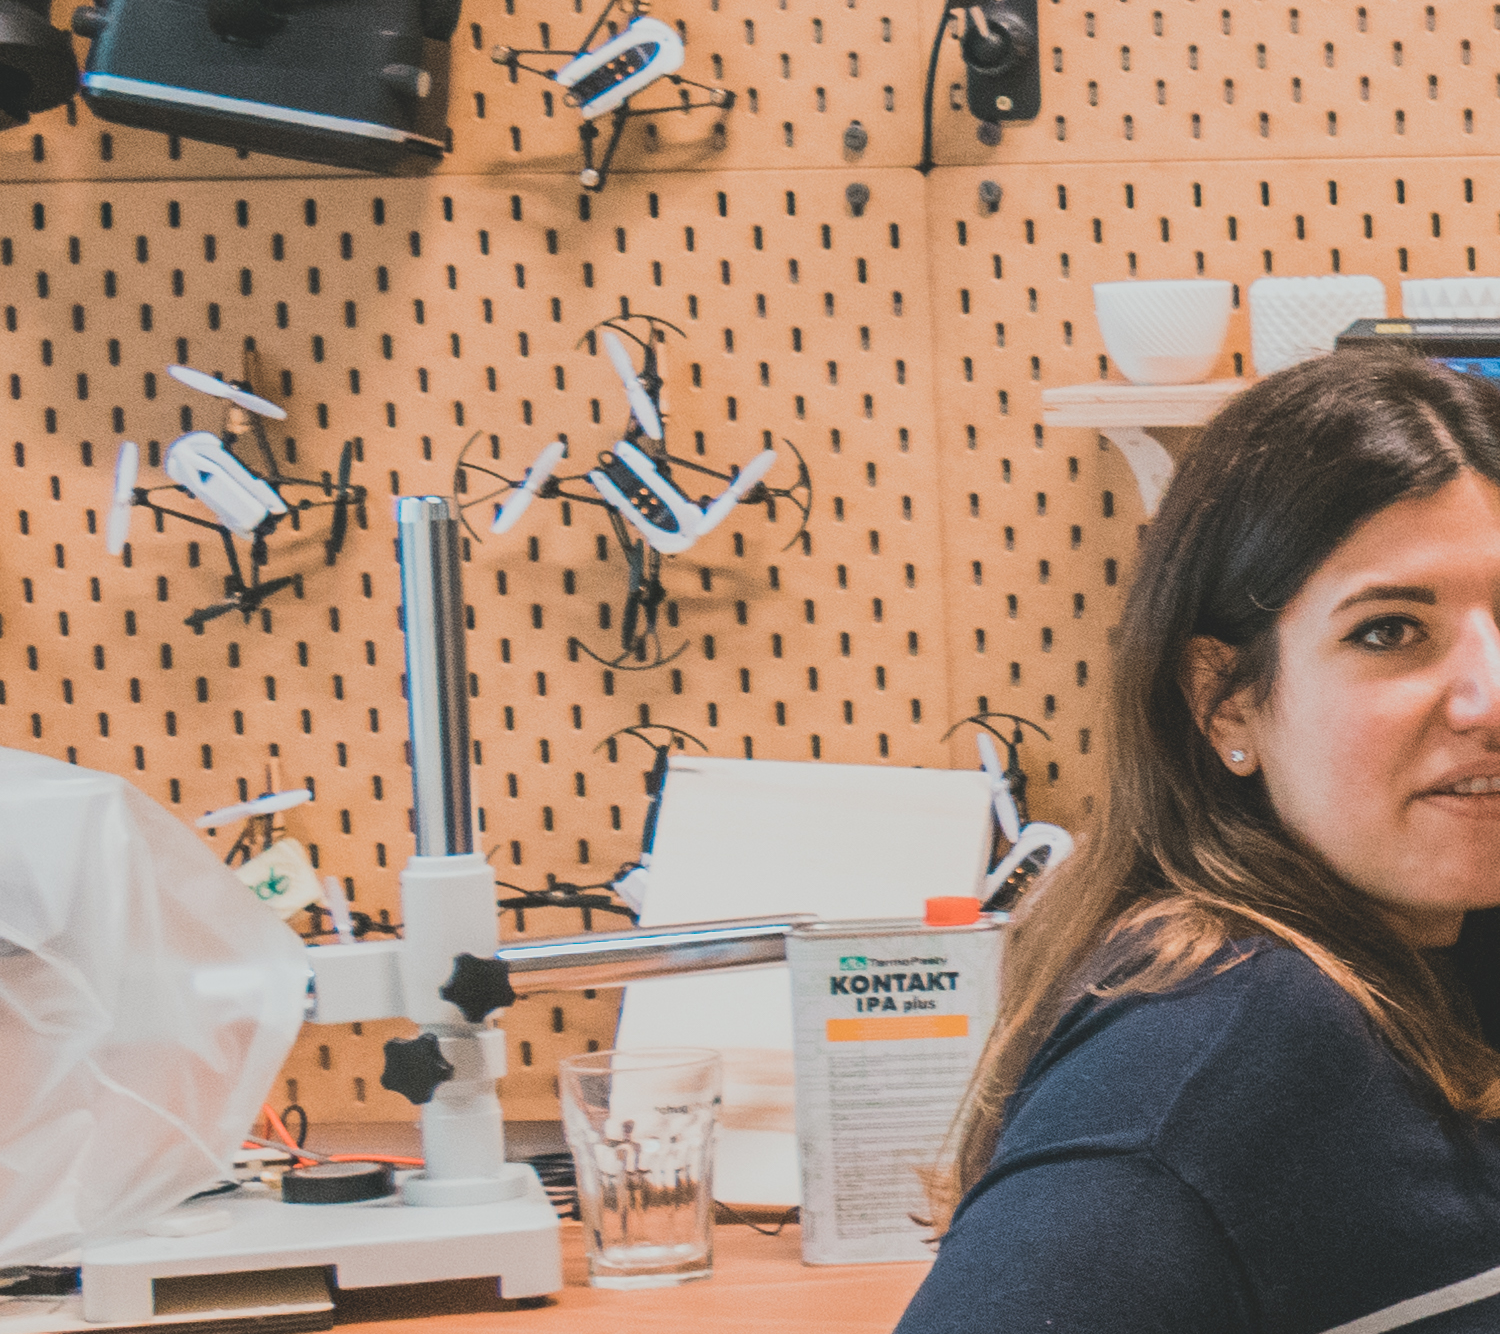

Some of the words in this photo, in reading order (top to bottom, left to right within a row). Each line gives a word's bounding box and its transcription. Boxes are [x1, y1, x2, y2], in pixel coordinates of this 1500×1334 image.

[830, 971, 959, 995] KONTAKT
[856, 996, 897, 1012] IPA
[904, 995, 936, 1013] plus
